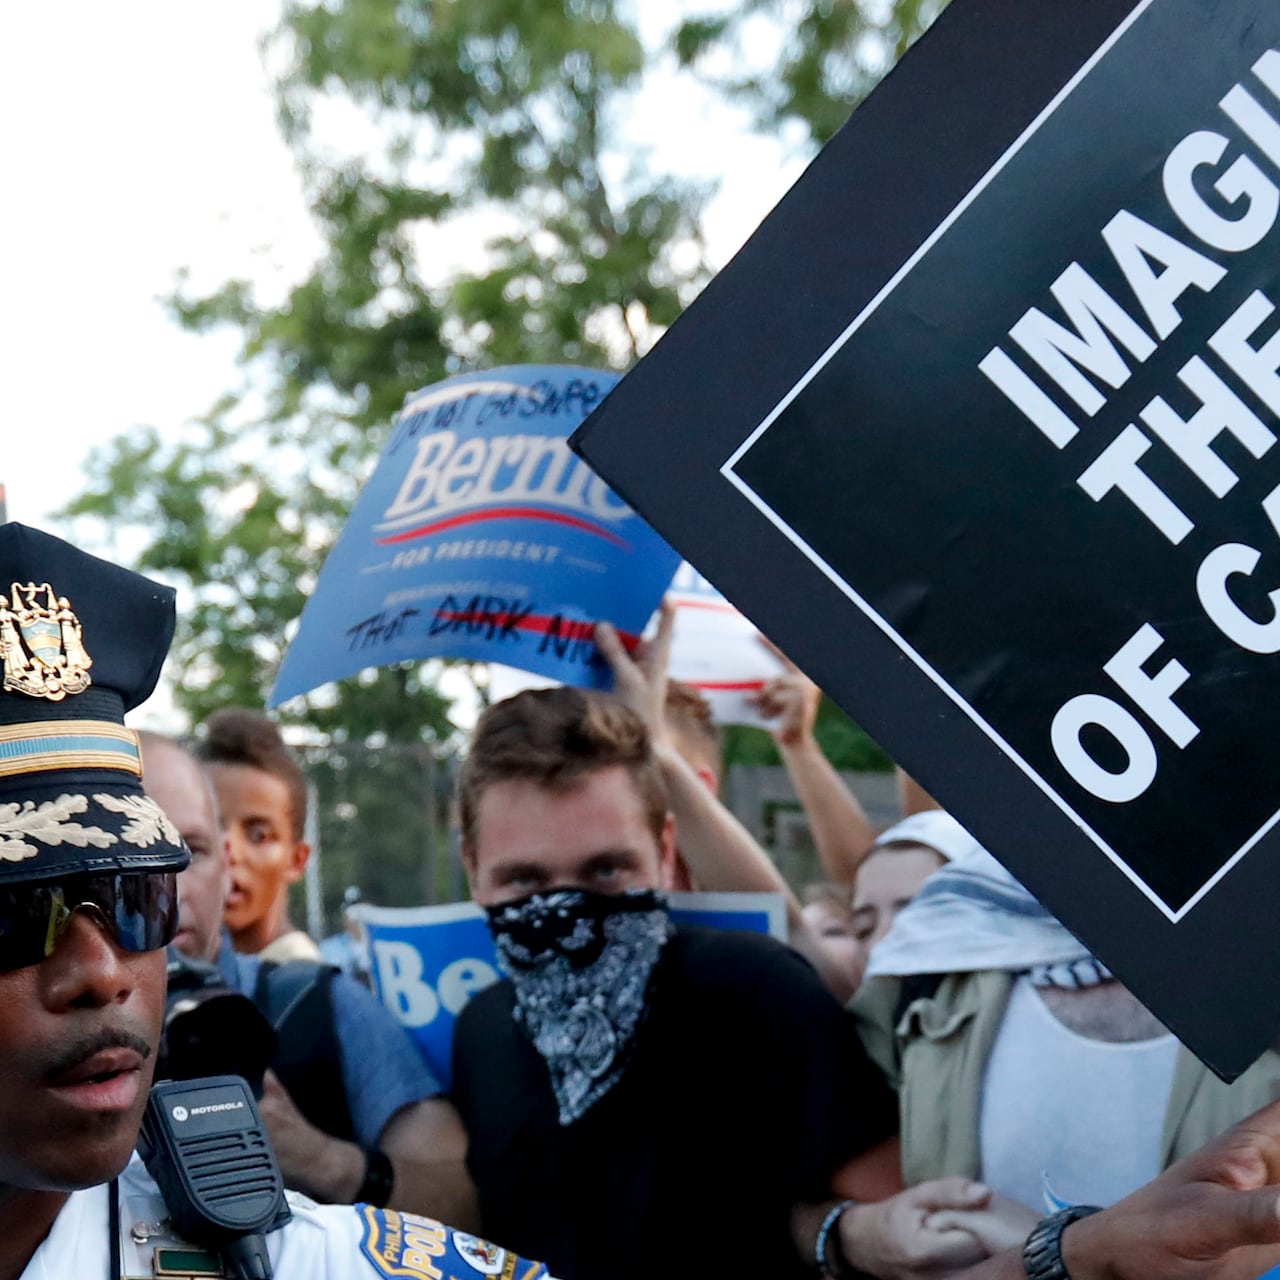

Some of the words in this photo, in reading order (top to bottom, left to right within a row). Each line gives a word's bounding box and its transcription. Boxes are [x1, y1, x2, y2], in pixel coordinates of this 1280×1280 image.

[391, 546, 432, 570] FOR
[434, 539, 561, 564] PRESIDENT
[428, 594, 536, 642] DARK
[1050, 622, 1200, 802] OF
[190, 1101, 244, 1115] MOTOROLA
